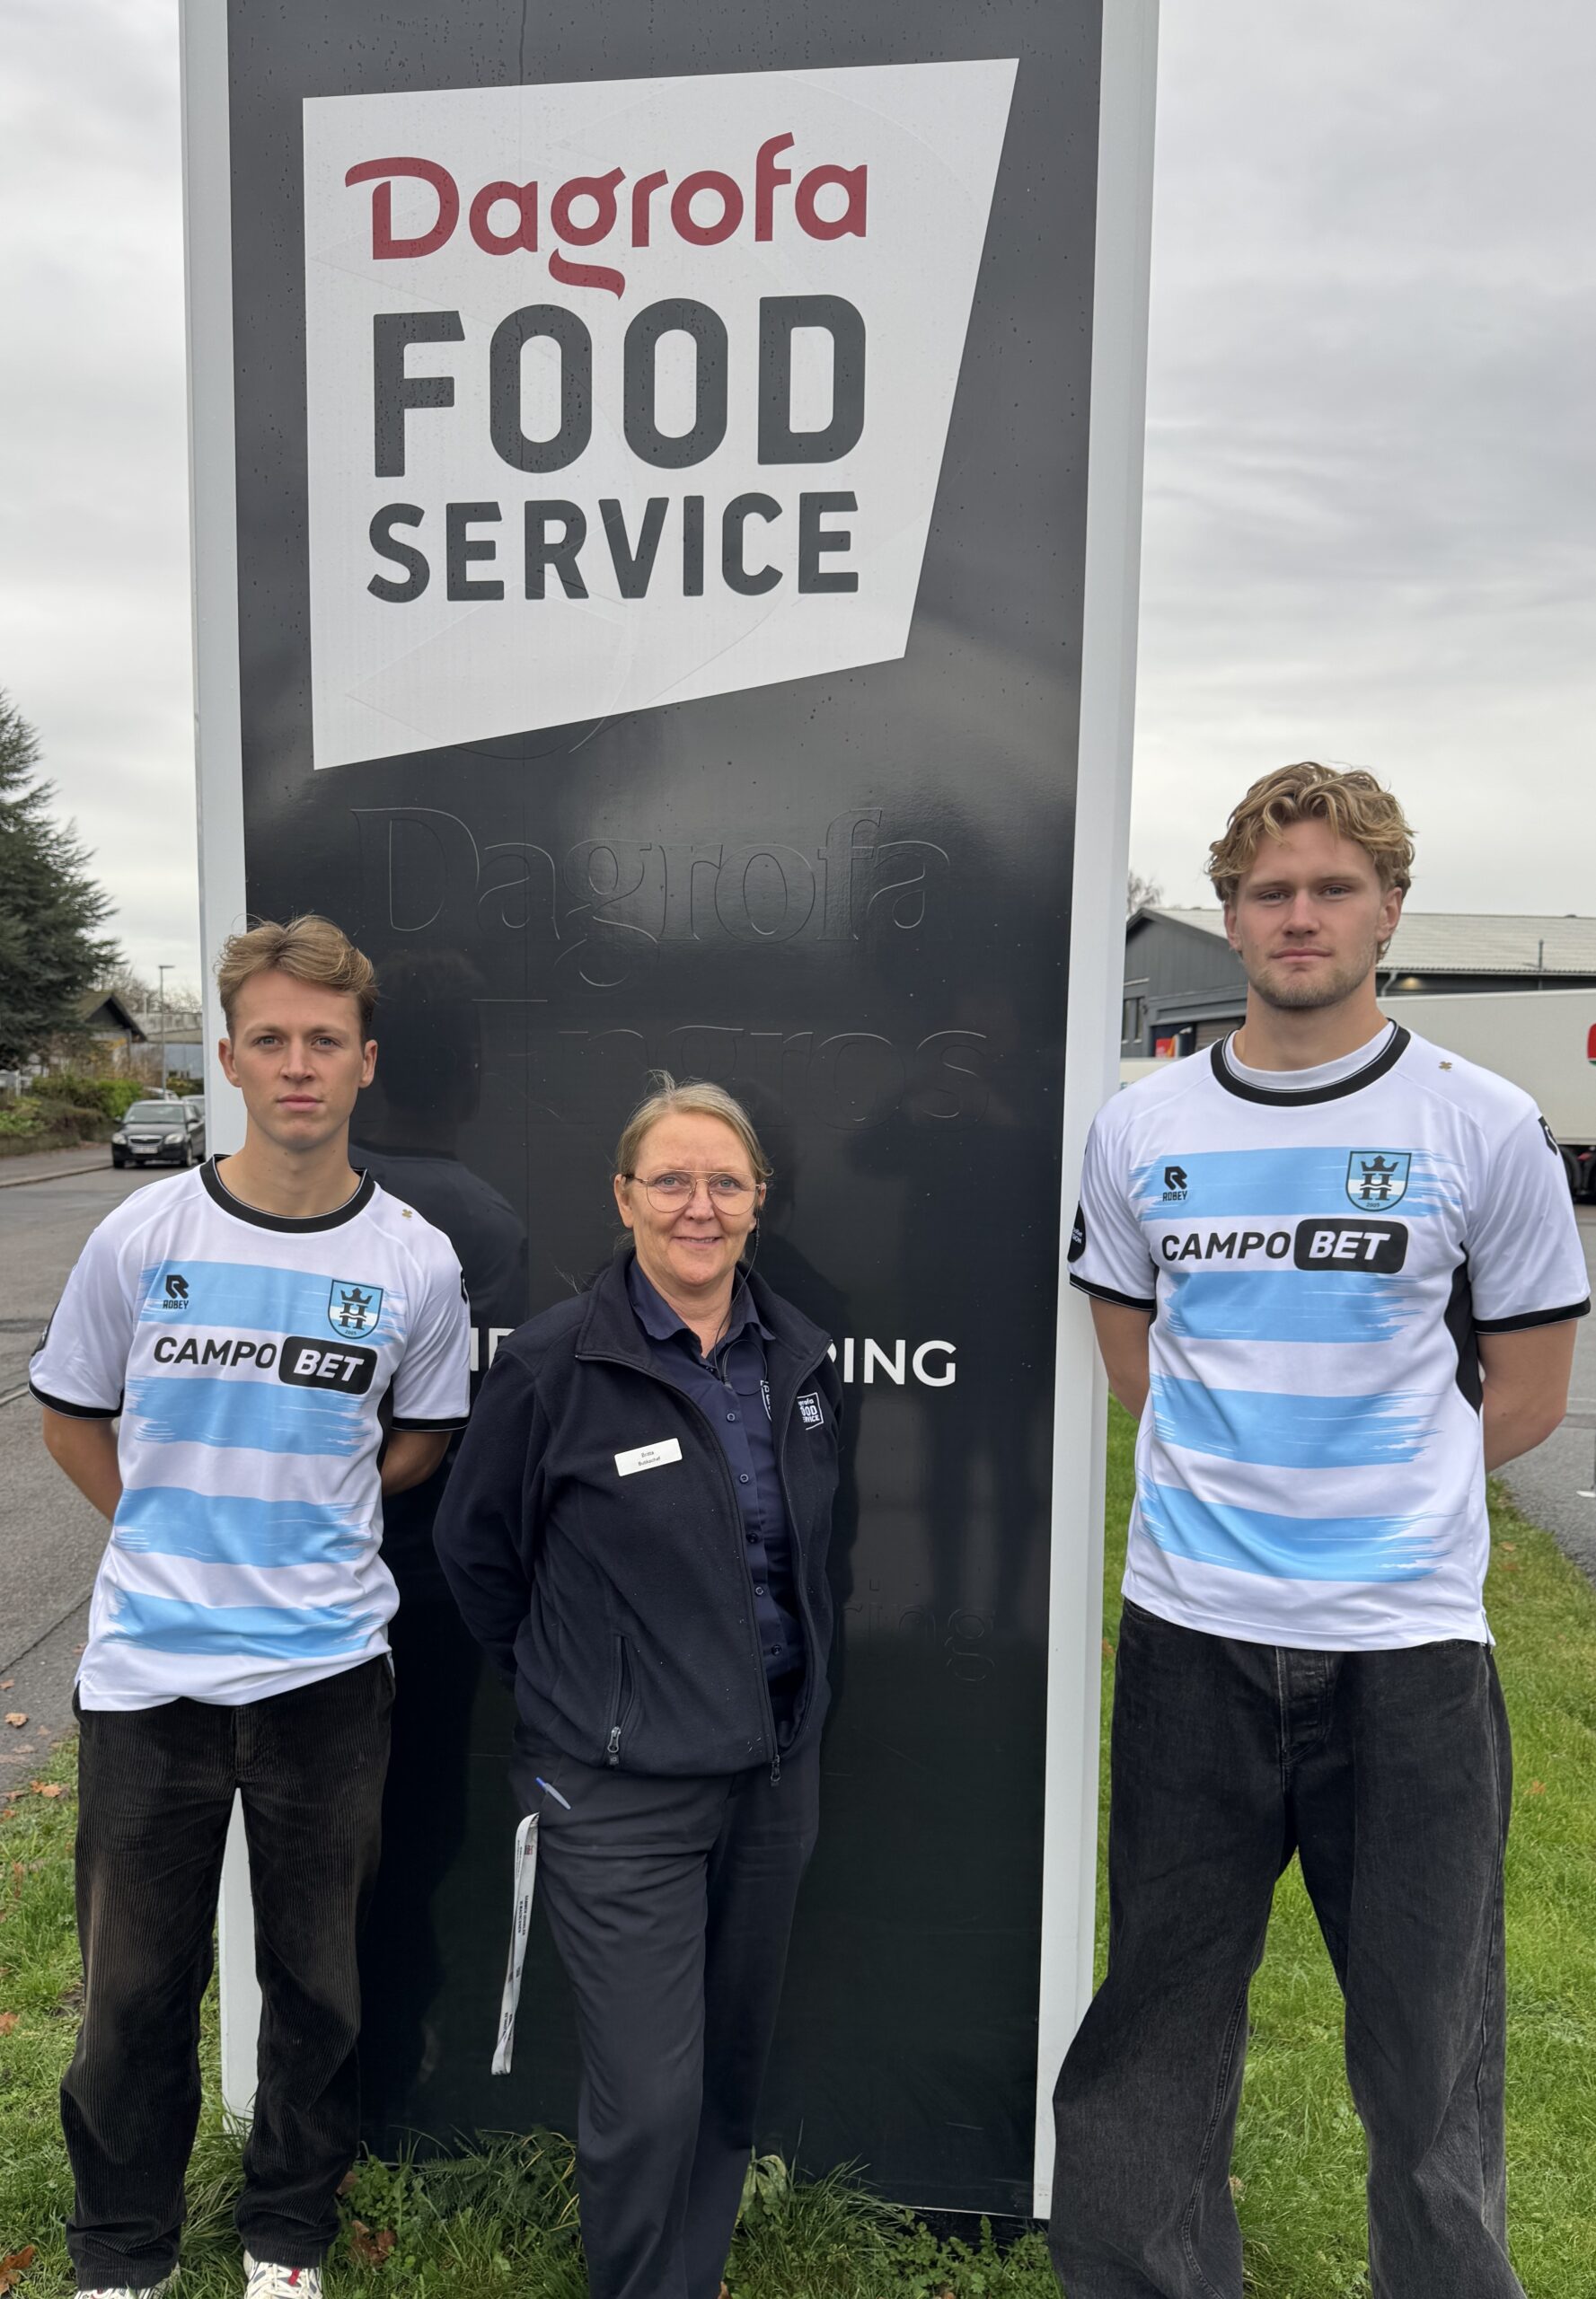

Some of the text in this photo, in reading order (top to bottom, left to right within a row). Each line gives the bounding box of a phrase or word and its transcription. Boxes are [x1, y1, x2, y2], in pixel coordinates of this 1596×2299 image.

[345, 132, 868, 299] Dagrofa
[374, 295, 867, 477] FOOD
[366, 491, 859, 603] SERVICE
[1162, 1191, 1187, 1202] ROBEY
[1161, 1230, 1391, 1261] CAMPO BET
[163, 1299, 190, 1309] ROBEY
[154, 1336, 365, 1382] CAMPO BET
[827, 1337, 957, 1387] ING
[800, 1405, 817, 1416] OOD
